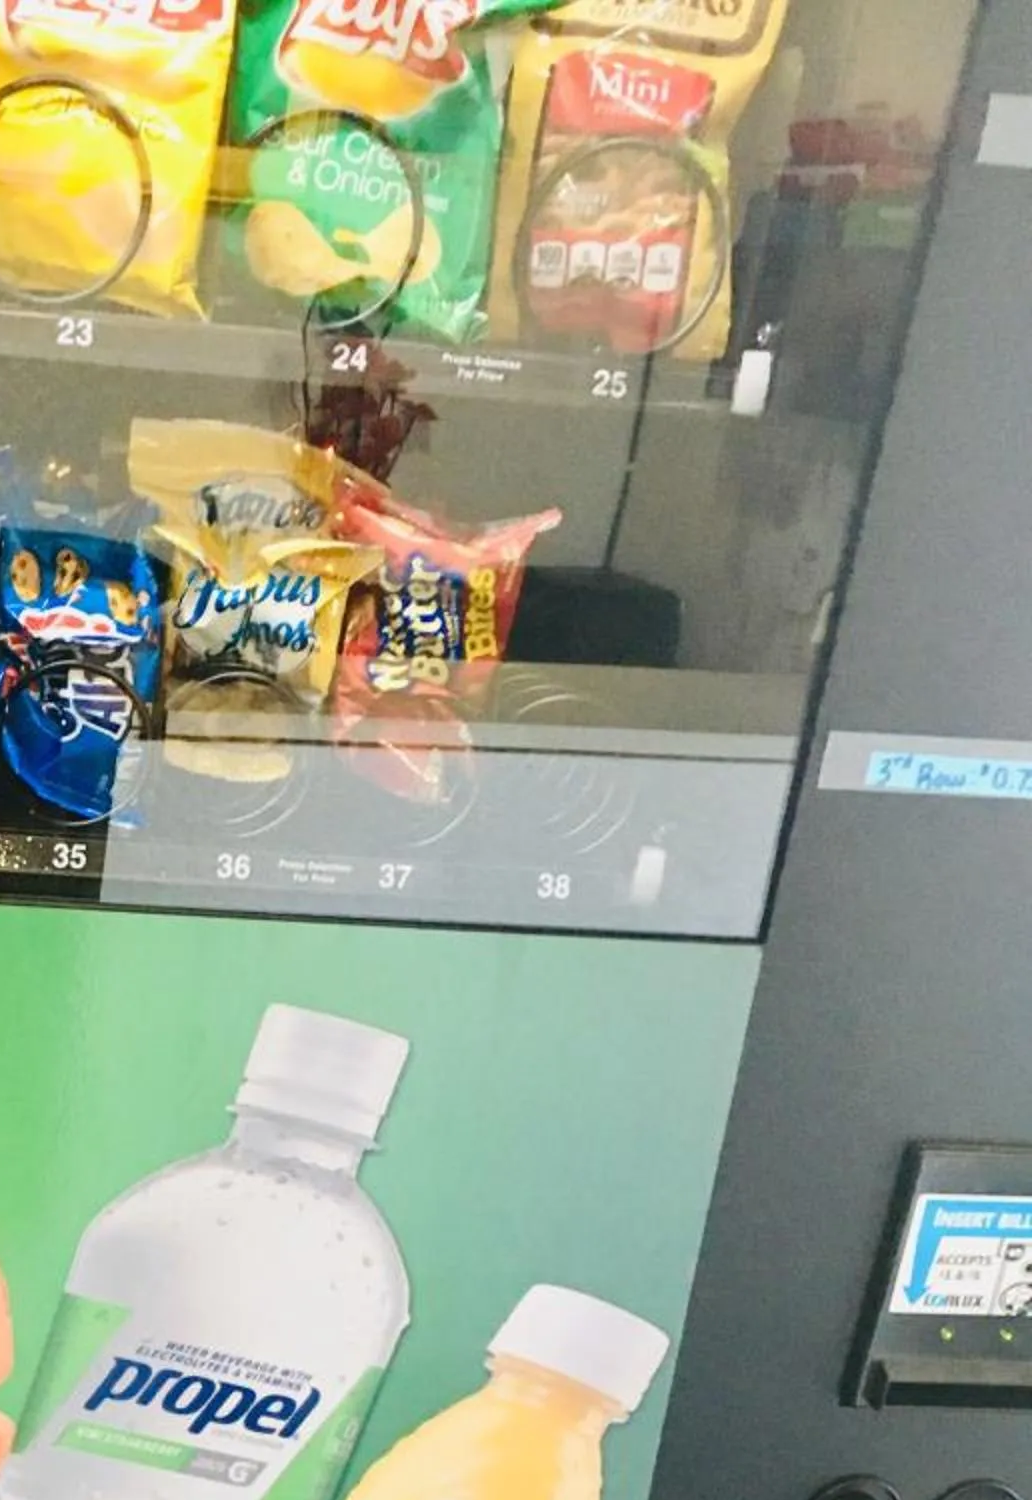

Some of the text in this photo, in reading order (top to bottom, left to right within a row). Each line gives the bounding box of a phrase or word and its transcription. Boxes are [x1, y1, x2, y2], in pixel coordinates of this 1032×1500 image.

[56, 316, 94, 347] 23
[331, 342, 368, 373] 24
[592, 368, 628, 399] 25
[464, 567, 499, 661] Bites
[52, 844, 87, 870] 35
[216, 853, 252, 880] 36
[378, 863, 415, 889] 37
[536, 872, 571, 899] 38
[83, 1355, 322, 1440] propel
